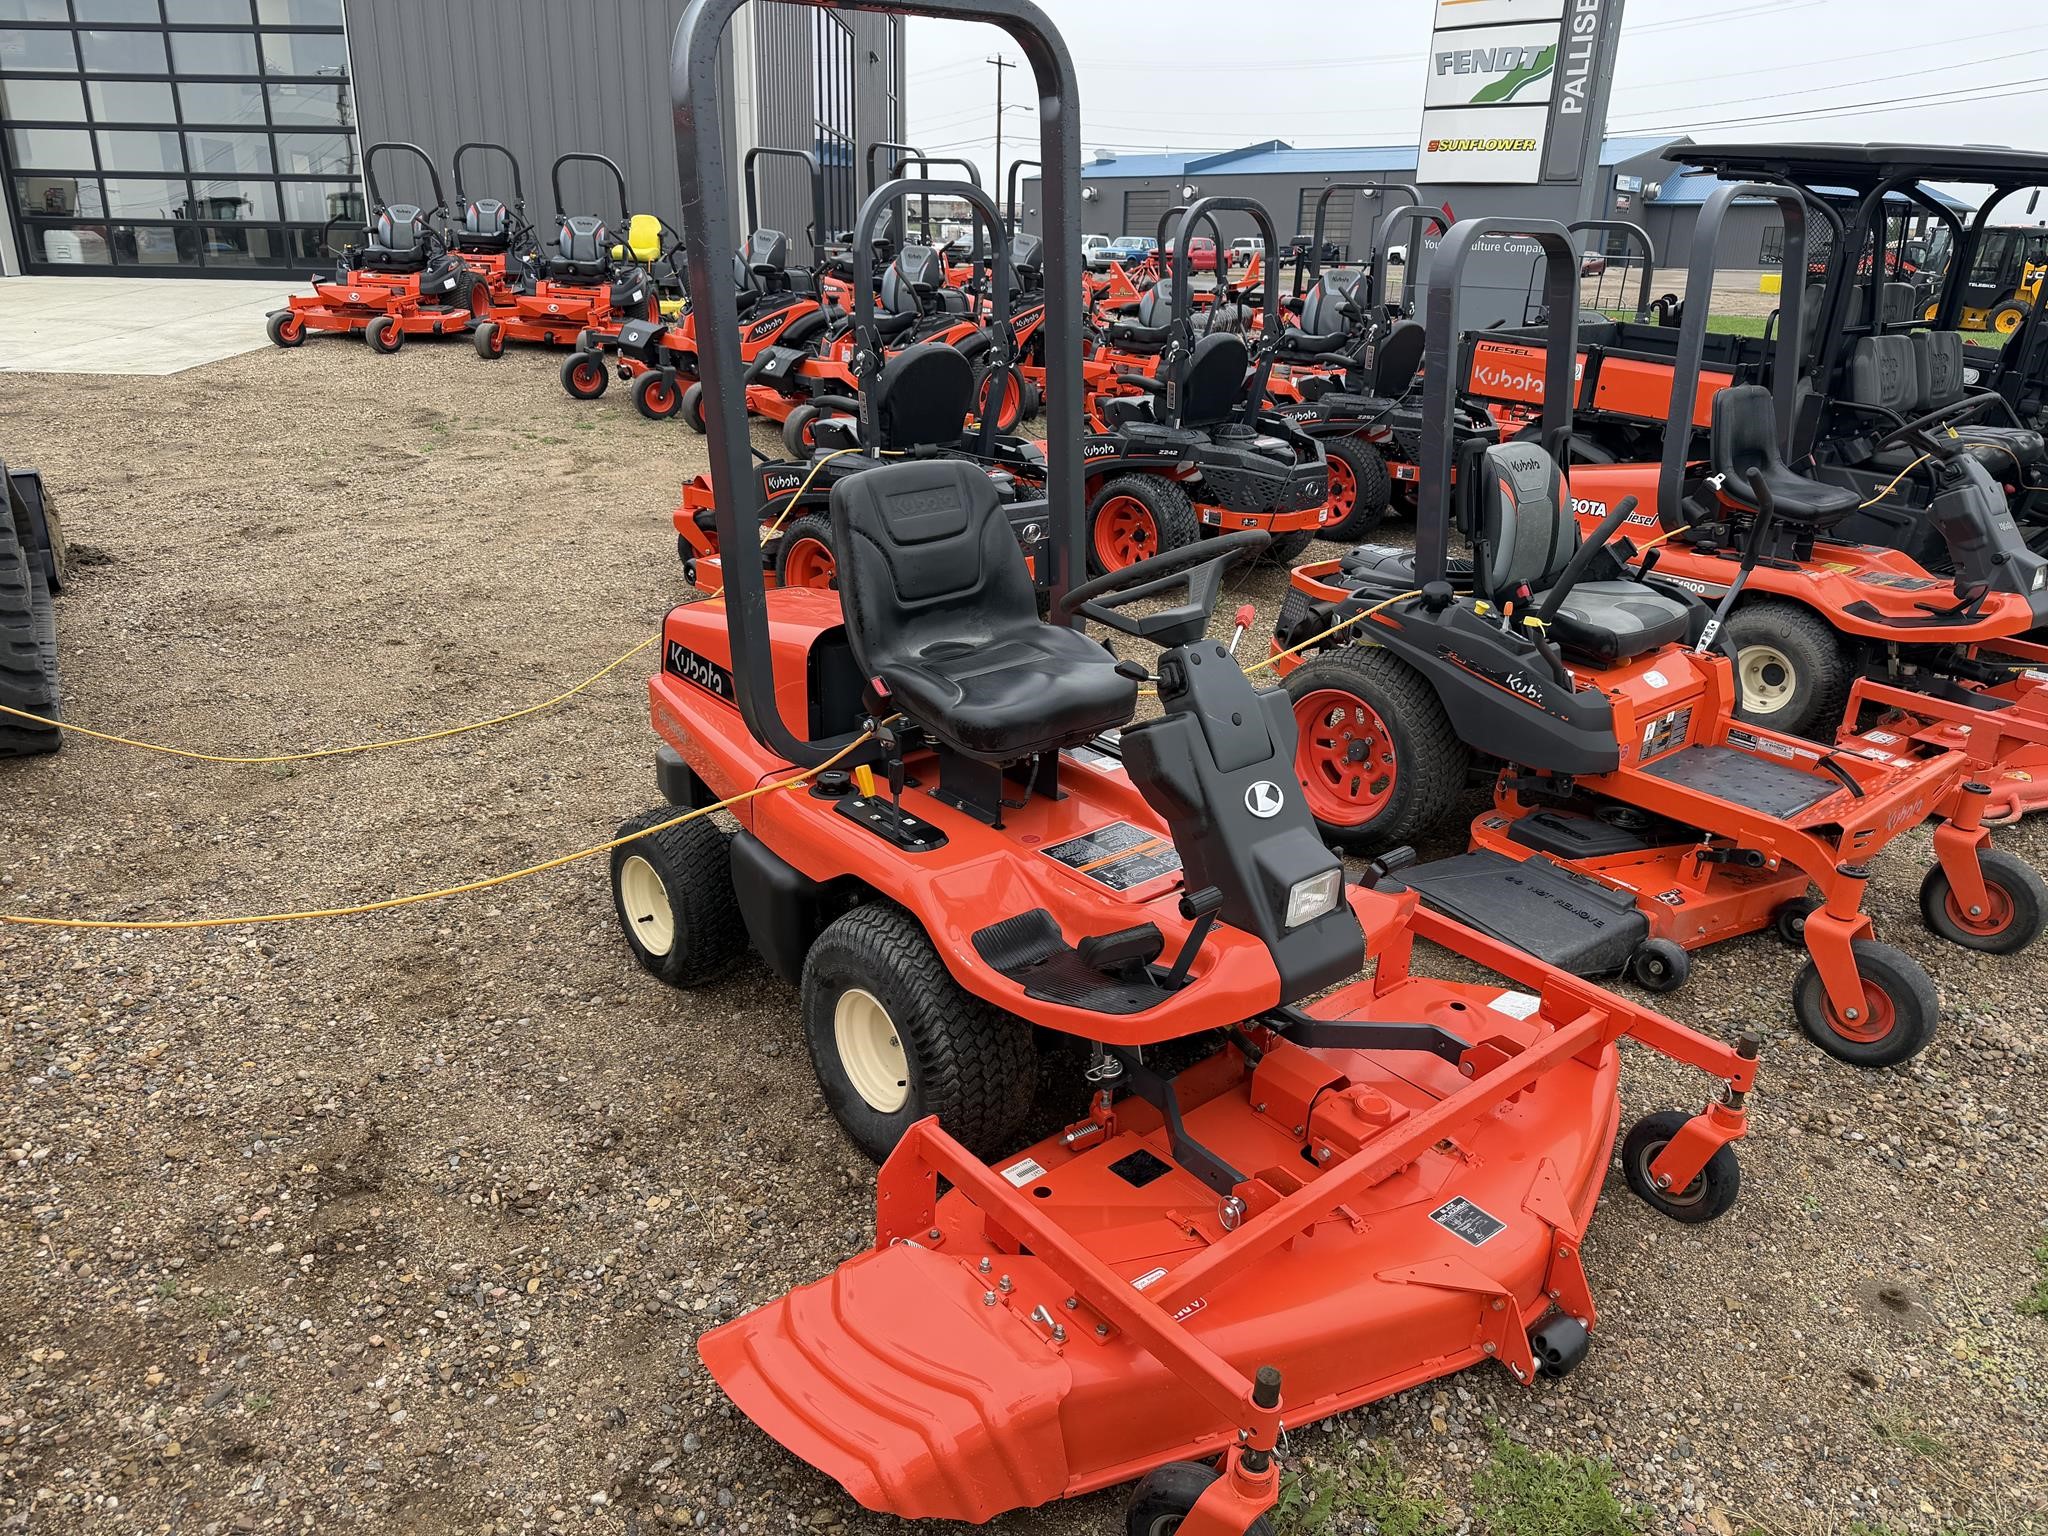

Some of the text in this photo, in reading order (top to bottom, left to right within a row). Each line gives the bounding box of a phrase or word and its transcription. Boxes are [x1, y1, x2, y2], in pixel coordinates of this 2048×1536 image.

[1435, 45, 1549, 75] FENDT
[1439, 138, 1537, 152] SUNFLOWER
[1424, 239, 1546, 256] You ulture Compan
[755, 317, 783, 334] Kubota
[1016, 312, 1040, 328] Kubota
[1480, 344, 1534, 357] DIESEL
[1474, 364, 1545, 393] Kubota
[1510, 457, 1541, 472] Kubota
[768, 473, 800, 489] Kubota
[1571, 498, 1607, 518] BOTA
[1628, 511, 1659, 527] iesel
[671, 641, 722, 695] Kubota
[1553, 898, 1606, 929] REMOVE
[1440, 1203, 1457, 1214] BLADE
